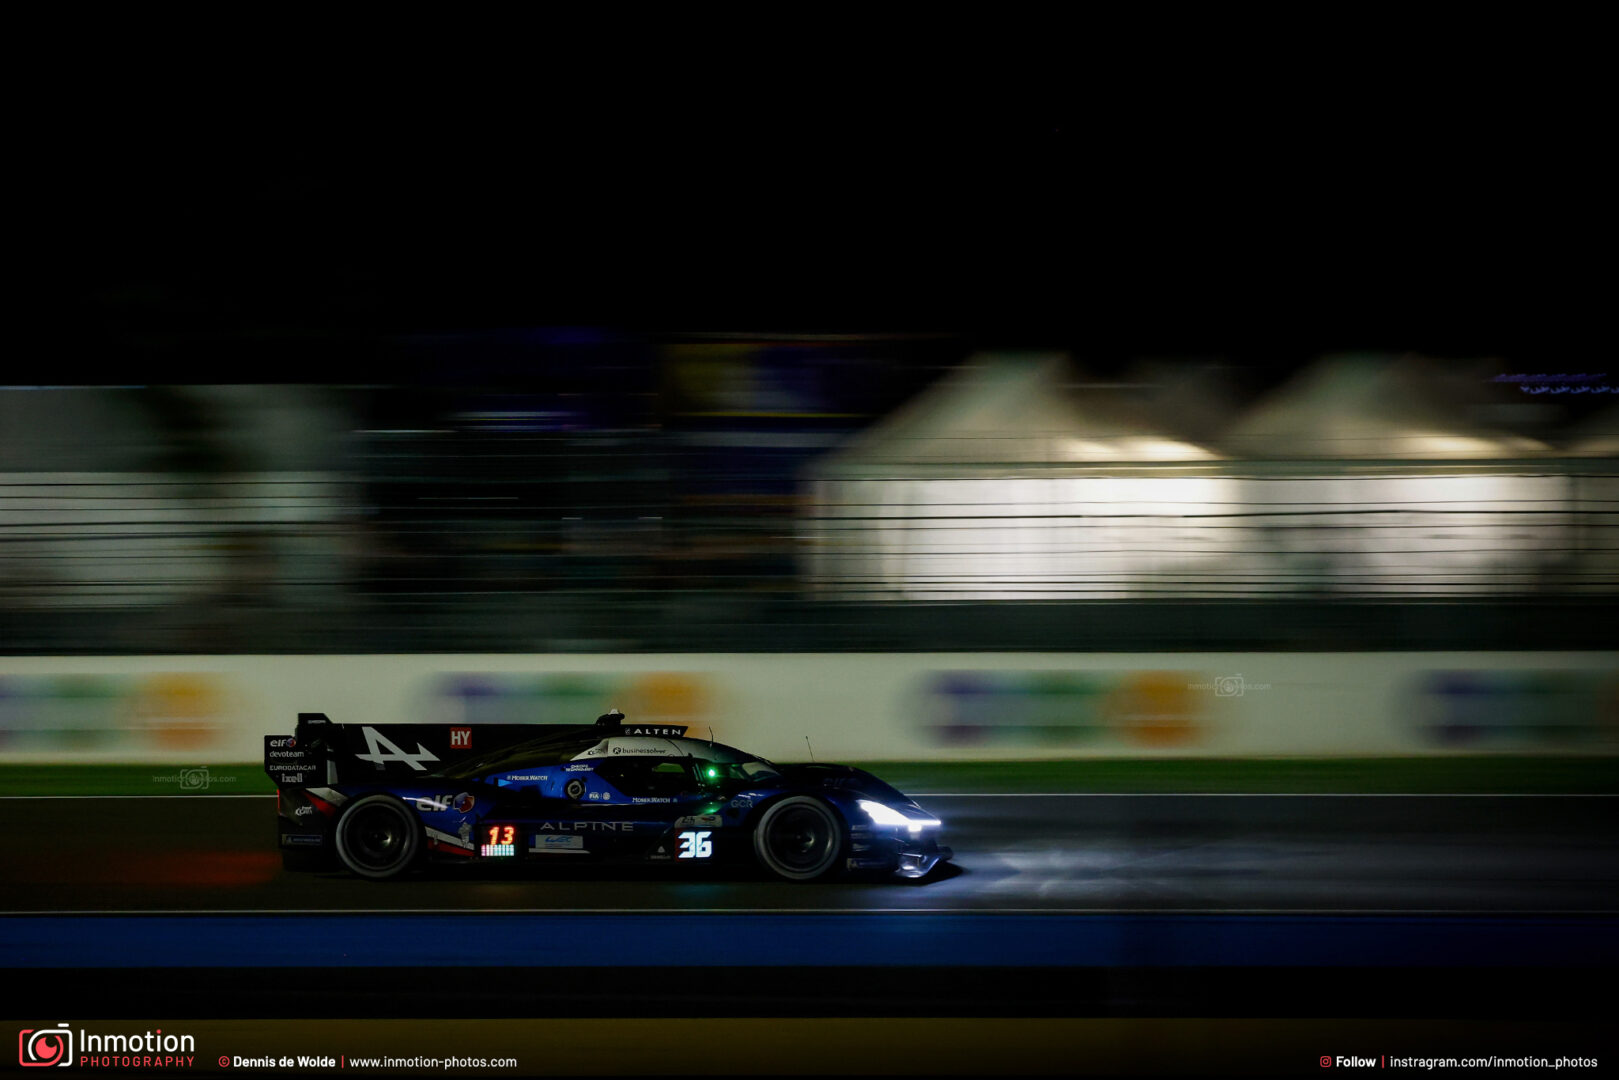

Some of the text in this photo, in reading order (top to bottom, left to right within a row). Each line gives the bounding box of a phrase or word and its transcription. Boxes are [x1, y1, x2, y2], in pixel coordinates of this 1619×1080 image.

[270, 739, 287, 747] elf
[451, 731, 471, 745] HY
[416, 794, 453, 812] elf
[540, 821, 634, 831] ALPINE
[488, 826, 515, 846] 13
[678, 831, 713, 859] 36
